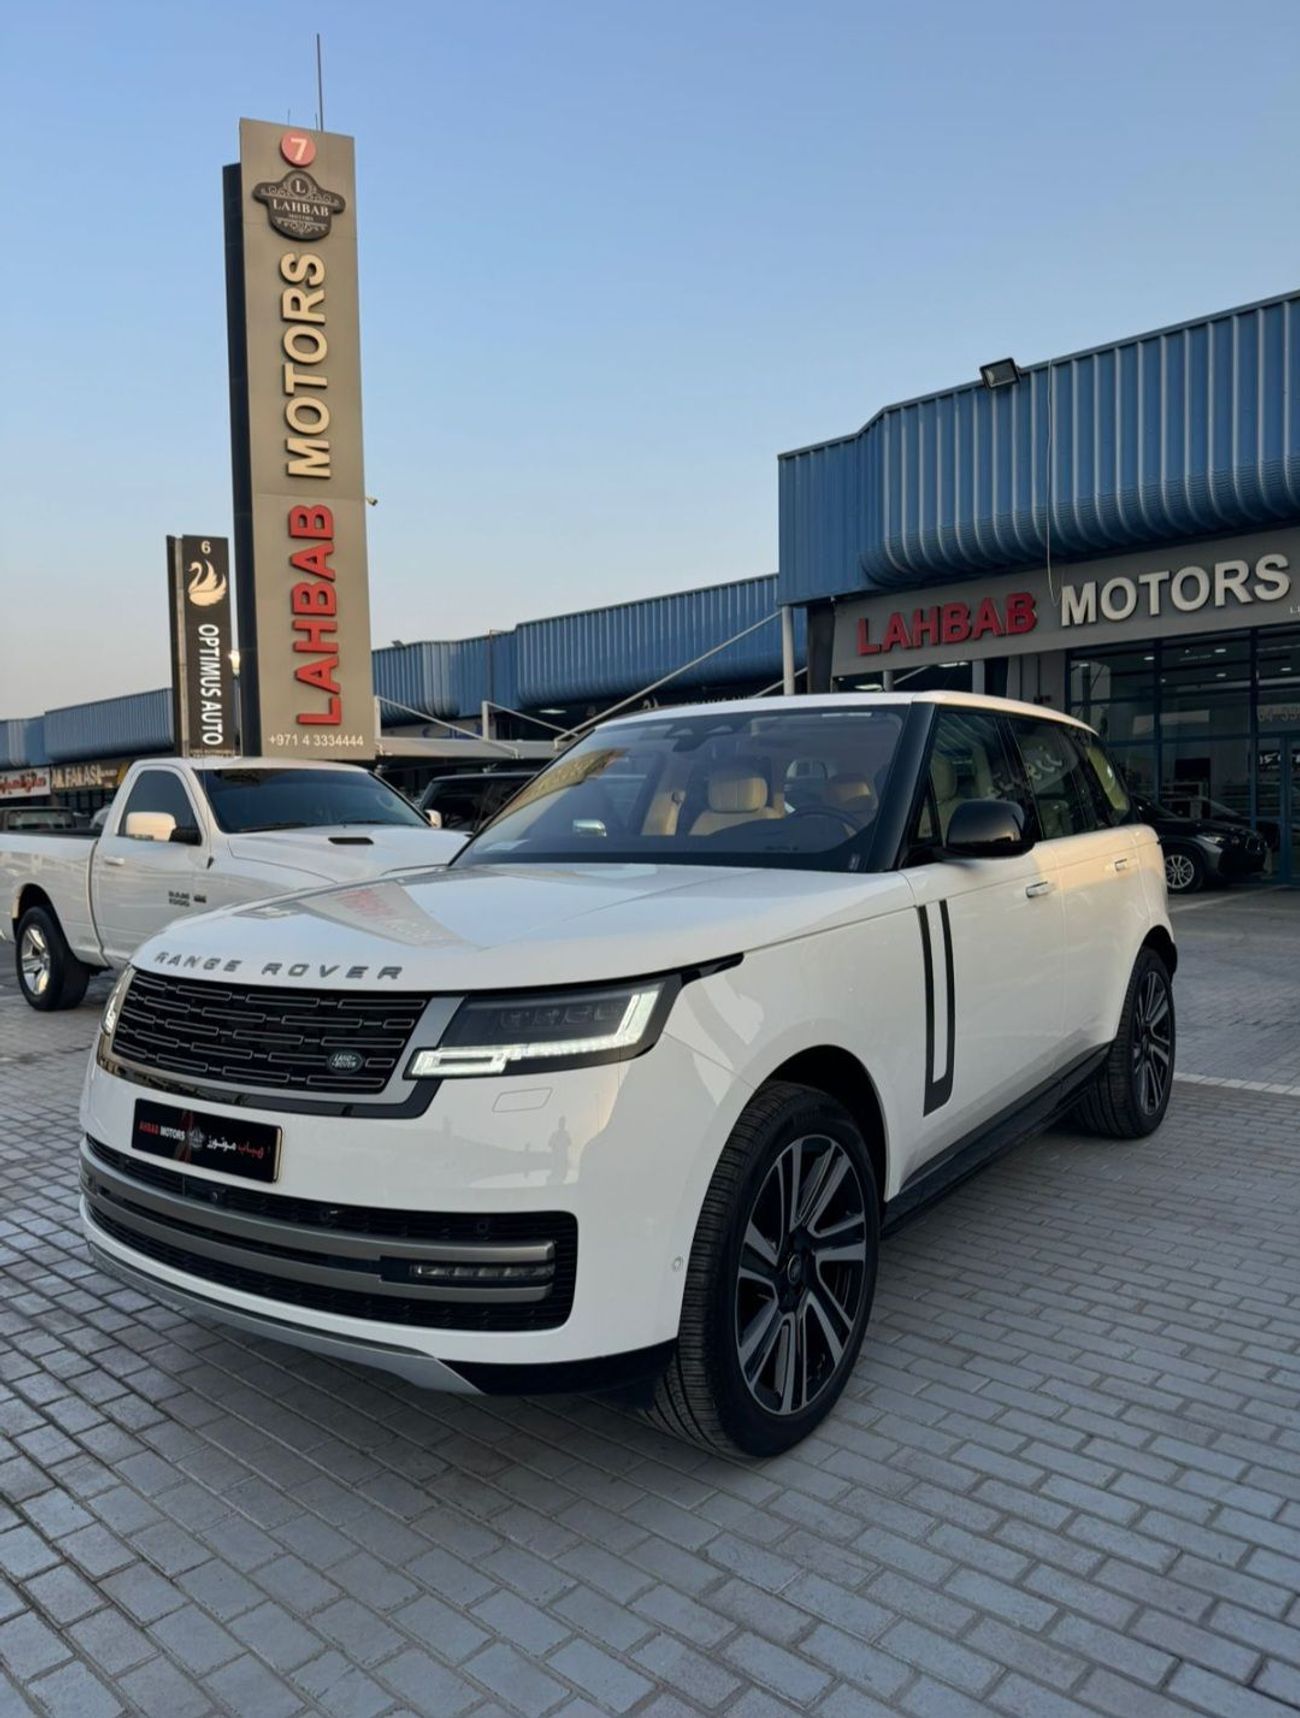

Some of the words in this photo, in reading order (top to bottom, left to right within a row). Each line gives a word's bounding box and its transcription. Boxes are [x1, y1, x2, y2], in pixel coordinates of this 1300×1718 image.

[290, 138, 308, 161] 7
[295, 180, 306, 194] L
[273, 199, 329, 217] LAHBAB
[280, 252, 331, 479] MOTORS
[201, 541, 211, 554] 6
[288, 504, 342, 726] LAHBAB
[857, 592, 1038, 656] LAHBAB
[1060, 553, 1292, 628] MOTORS
[199, 623, 222, 697] OPTIMUS
[201, 700, 224, 746] AUTO
[269, 733, 299, 747] +971
[302, 734, 310, 746] 4
[313, 734, 364, 747] 3334444
[154, 951, 243, 973] RANGE
[261, 962, 404, 980] ROVER
